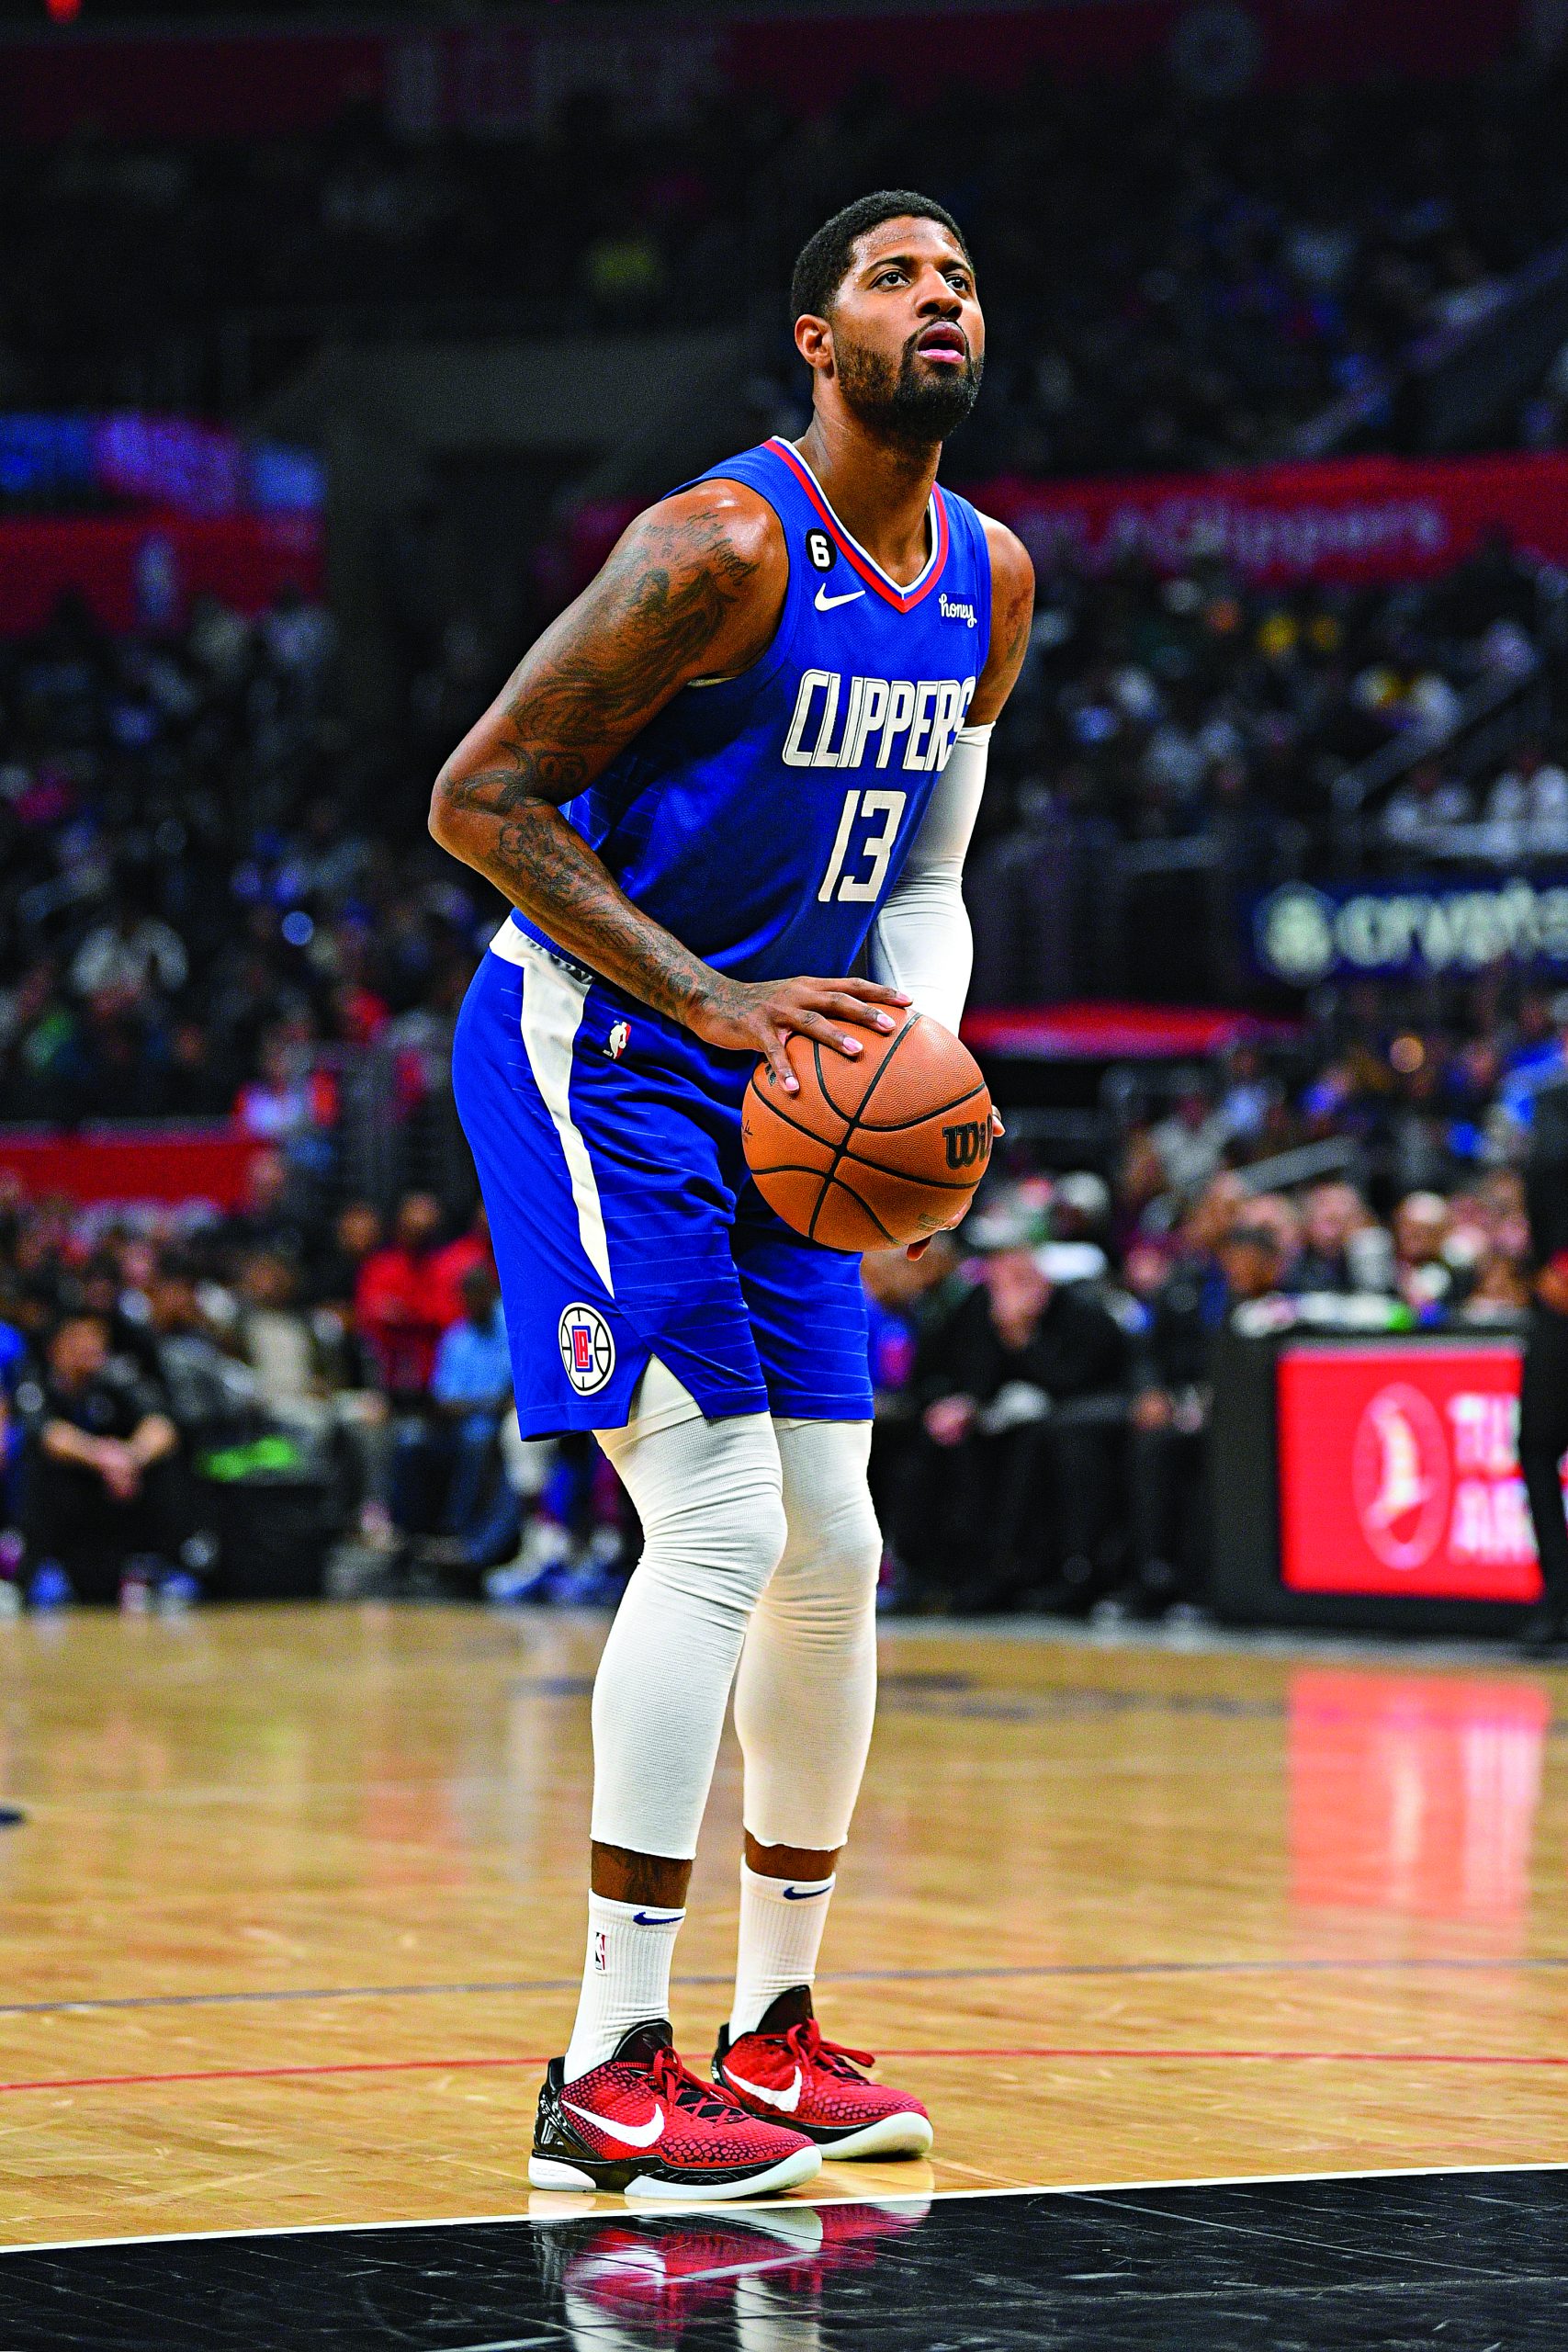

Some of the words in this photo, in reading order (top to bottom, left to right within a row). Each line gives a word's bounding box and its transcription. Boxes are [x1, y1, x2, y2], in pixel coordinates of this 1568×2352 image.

[810, 534, 831, 568] 6
[938, 593, 978, 628] honey
[818, 789, 907, 902] 13
